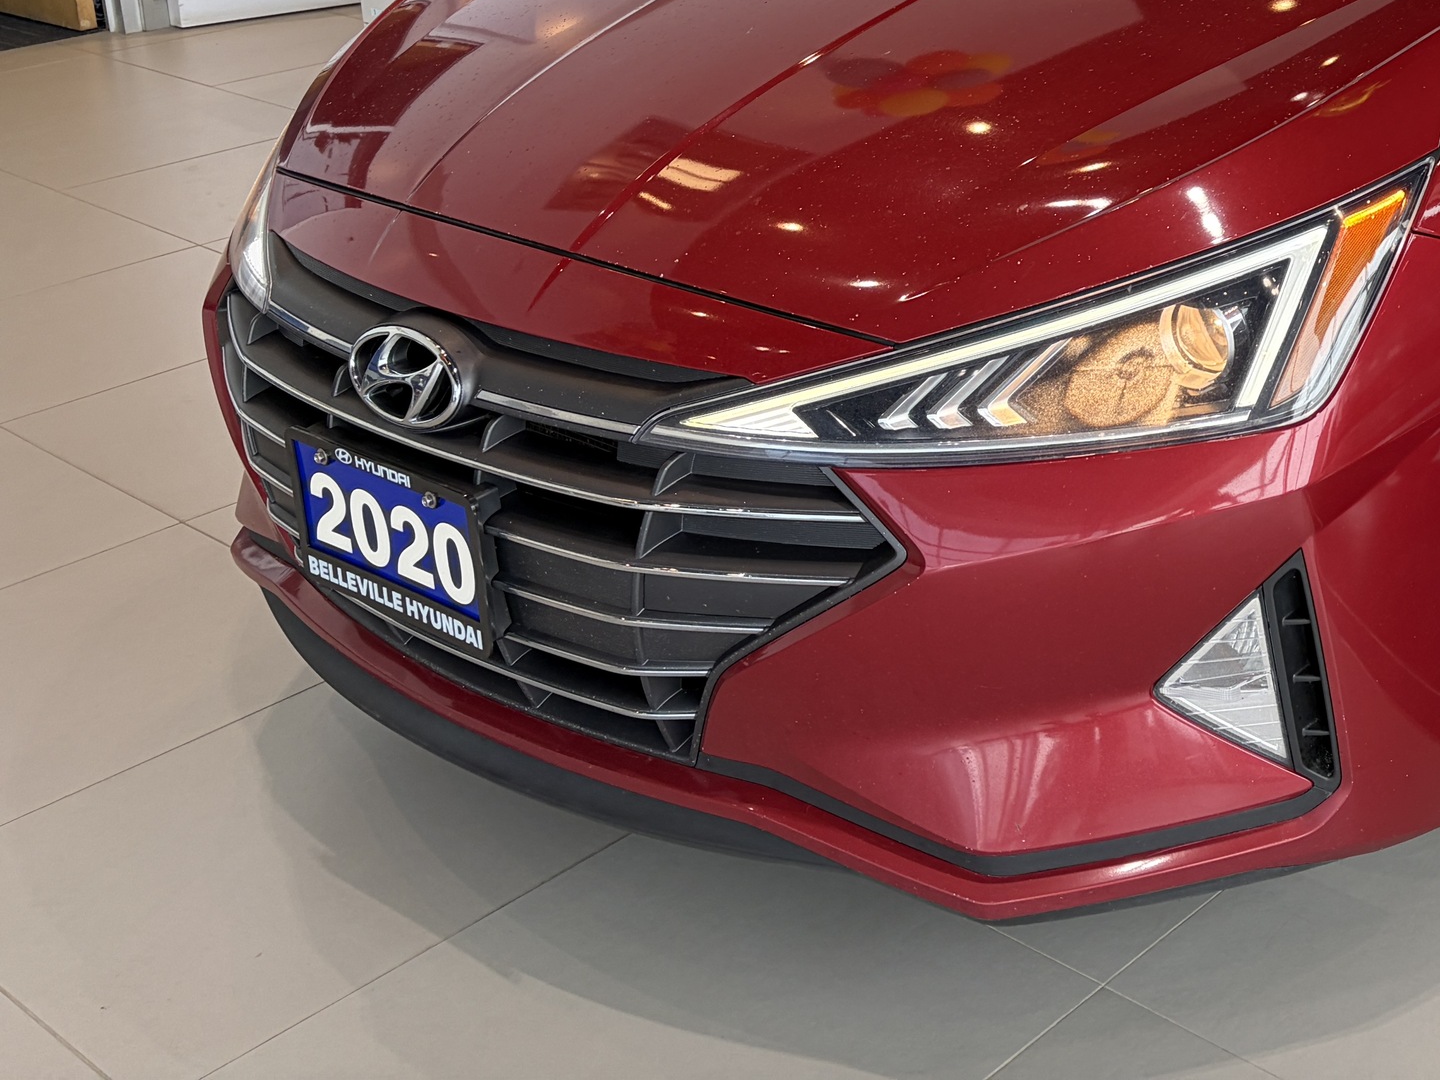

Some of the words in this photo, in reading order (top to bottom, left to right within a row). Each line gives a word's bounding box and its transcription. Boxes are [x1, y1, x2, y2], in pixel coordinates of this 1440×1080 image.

[354, 455, 411, 488] HYUNDAI
[310, 472, 476, 605] 2020
[308, 555, 404, 612] BELLEVILLE
[405, 596, 483, 651] HYUNDAI
